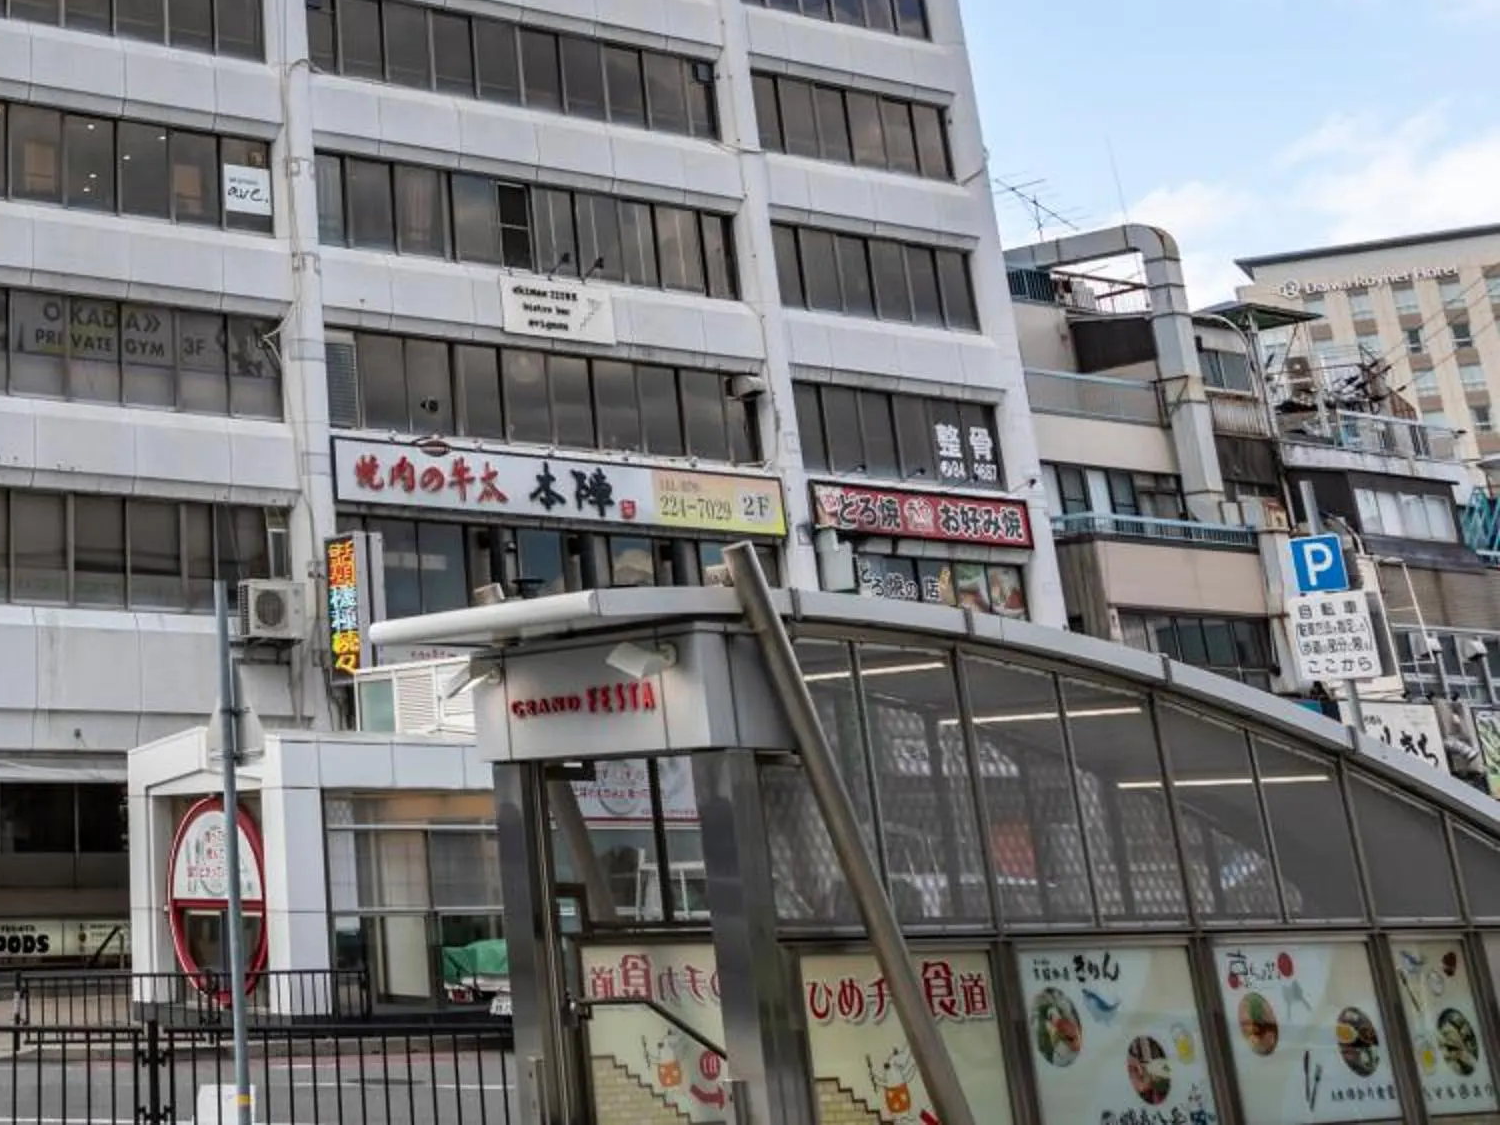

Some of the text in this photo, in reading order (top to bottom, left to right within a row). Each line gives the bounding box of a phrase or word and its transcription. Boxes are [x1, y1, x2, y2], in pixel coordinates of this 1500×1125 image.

[934, 423, 994, 461] 整骨
[528, 461, 617, 519] 本陣
[742, 495, 771, 518] 2F
[938, 499, 1025, 541] お好み焼
[1302, 542, 1333, 587] P
[1308, 656, 1373, 674] ここから
[511, 681, 656, 720] GRAND FESTA
